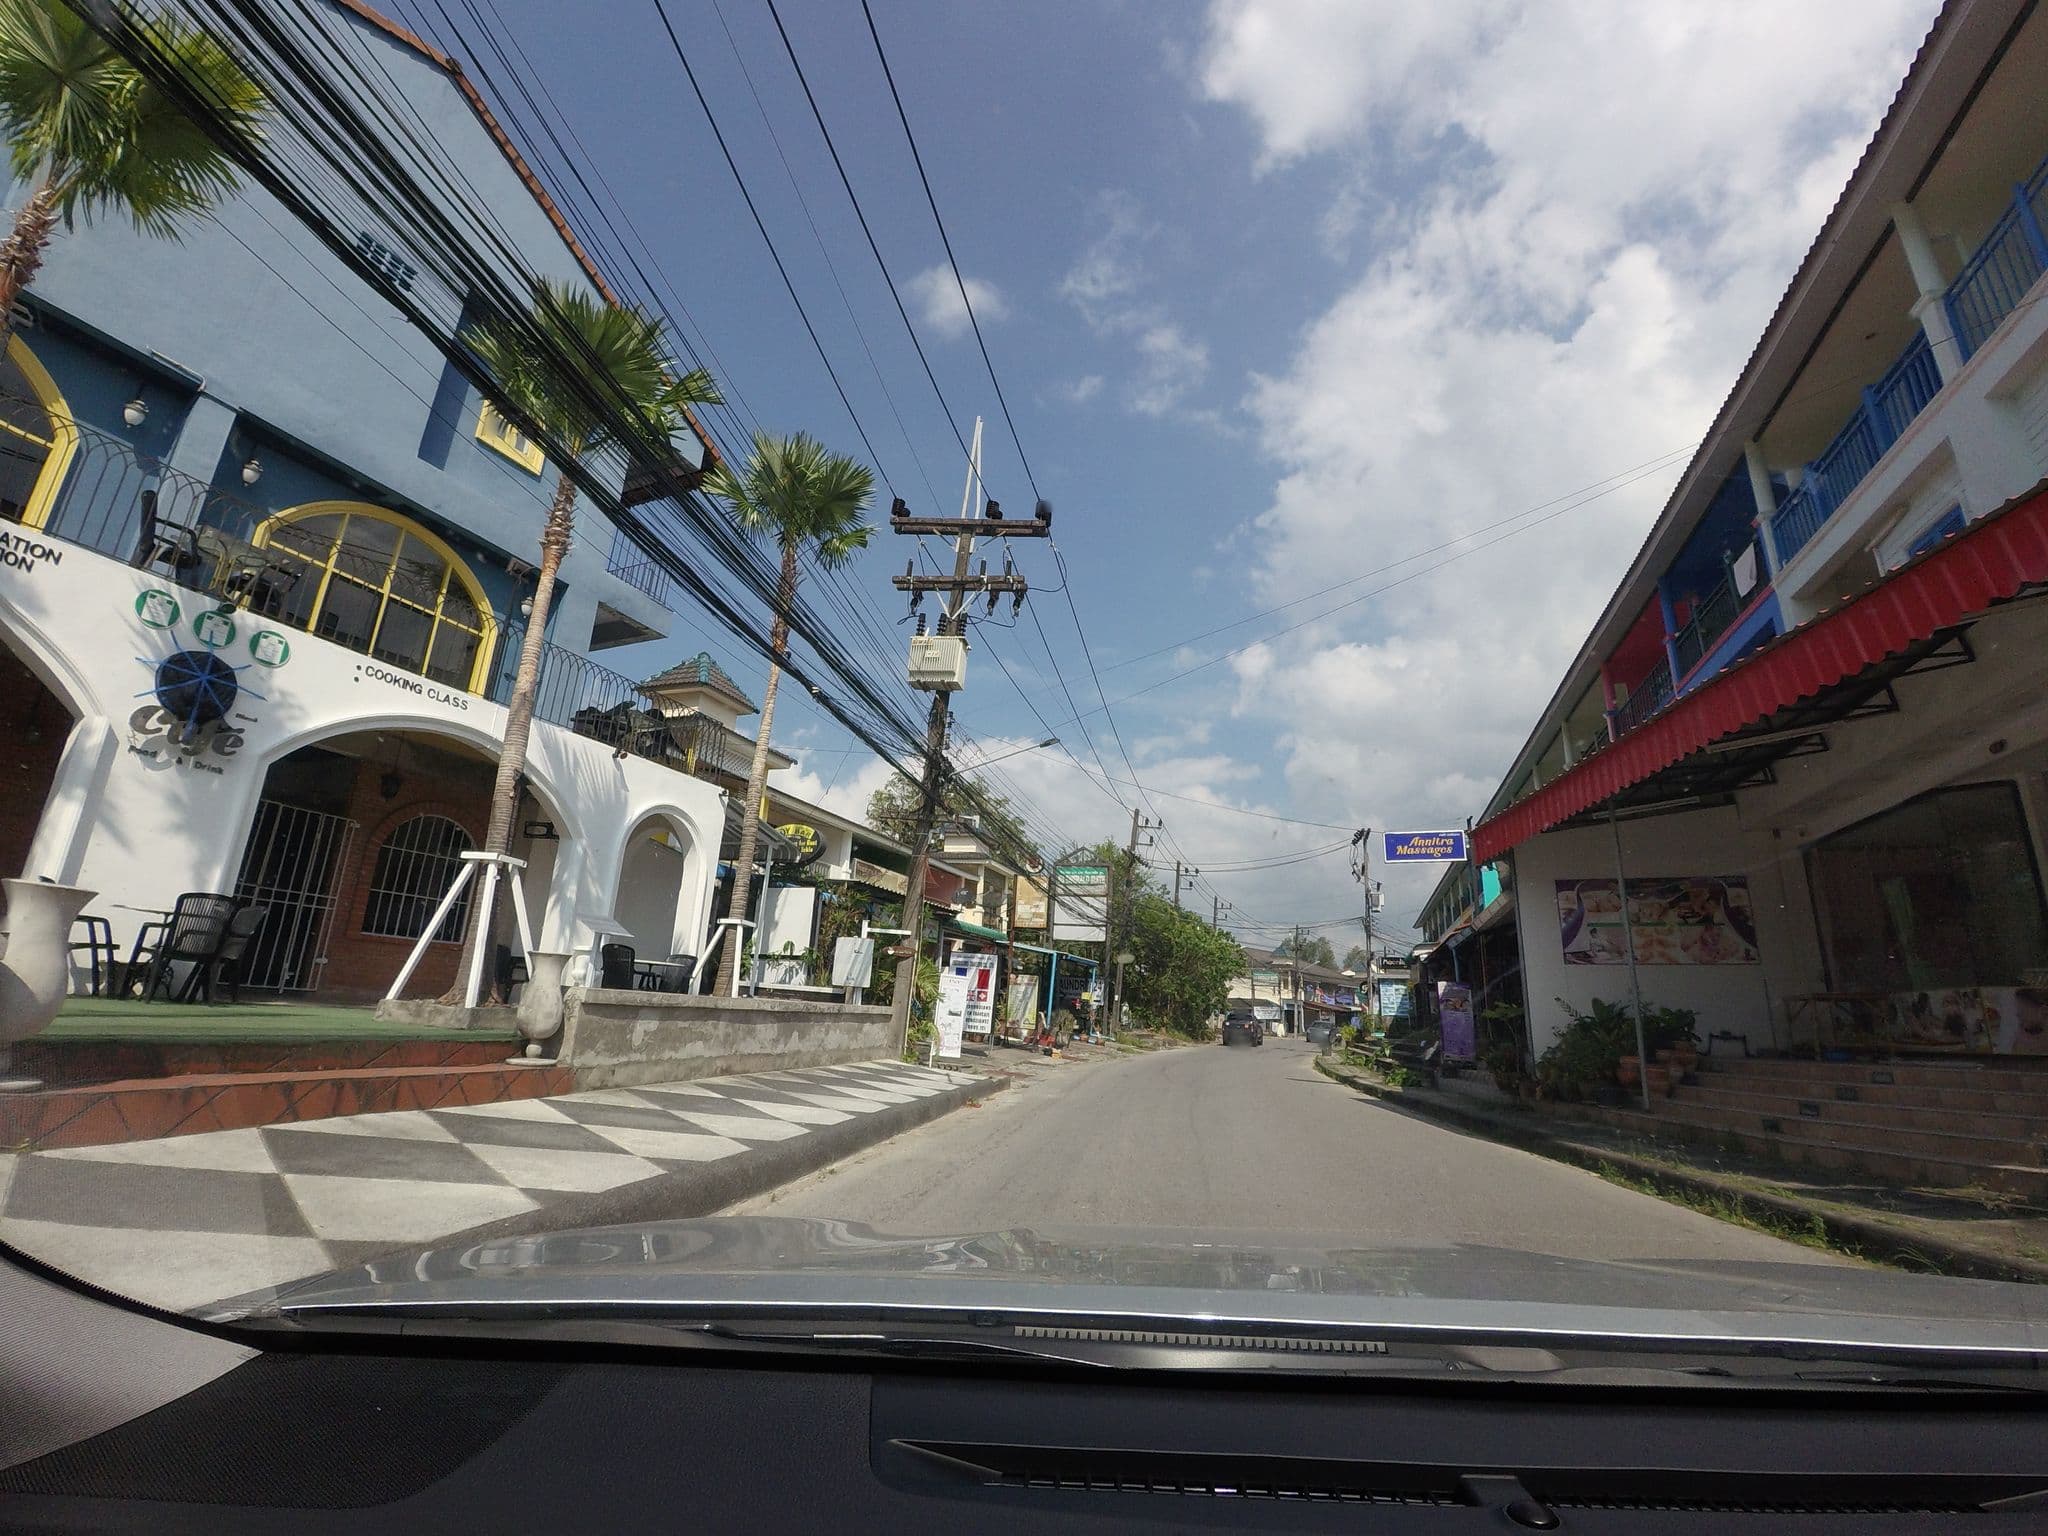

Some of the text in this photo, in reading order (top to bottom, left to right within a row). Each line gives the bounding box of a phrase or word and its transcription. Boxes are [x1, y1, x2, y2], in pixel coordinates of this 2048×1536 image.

[365, 665, 469, 711] COOKING CLASS
[194, 760, 224, 775] Drink
[1409, 837, 1454, 847] Annitra
[1396, 845, 1453, 857] Massages
